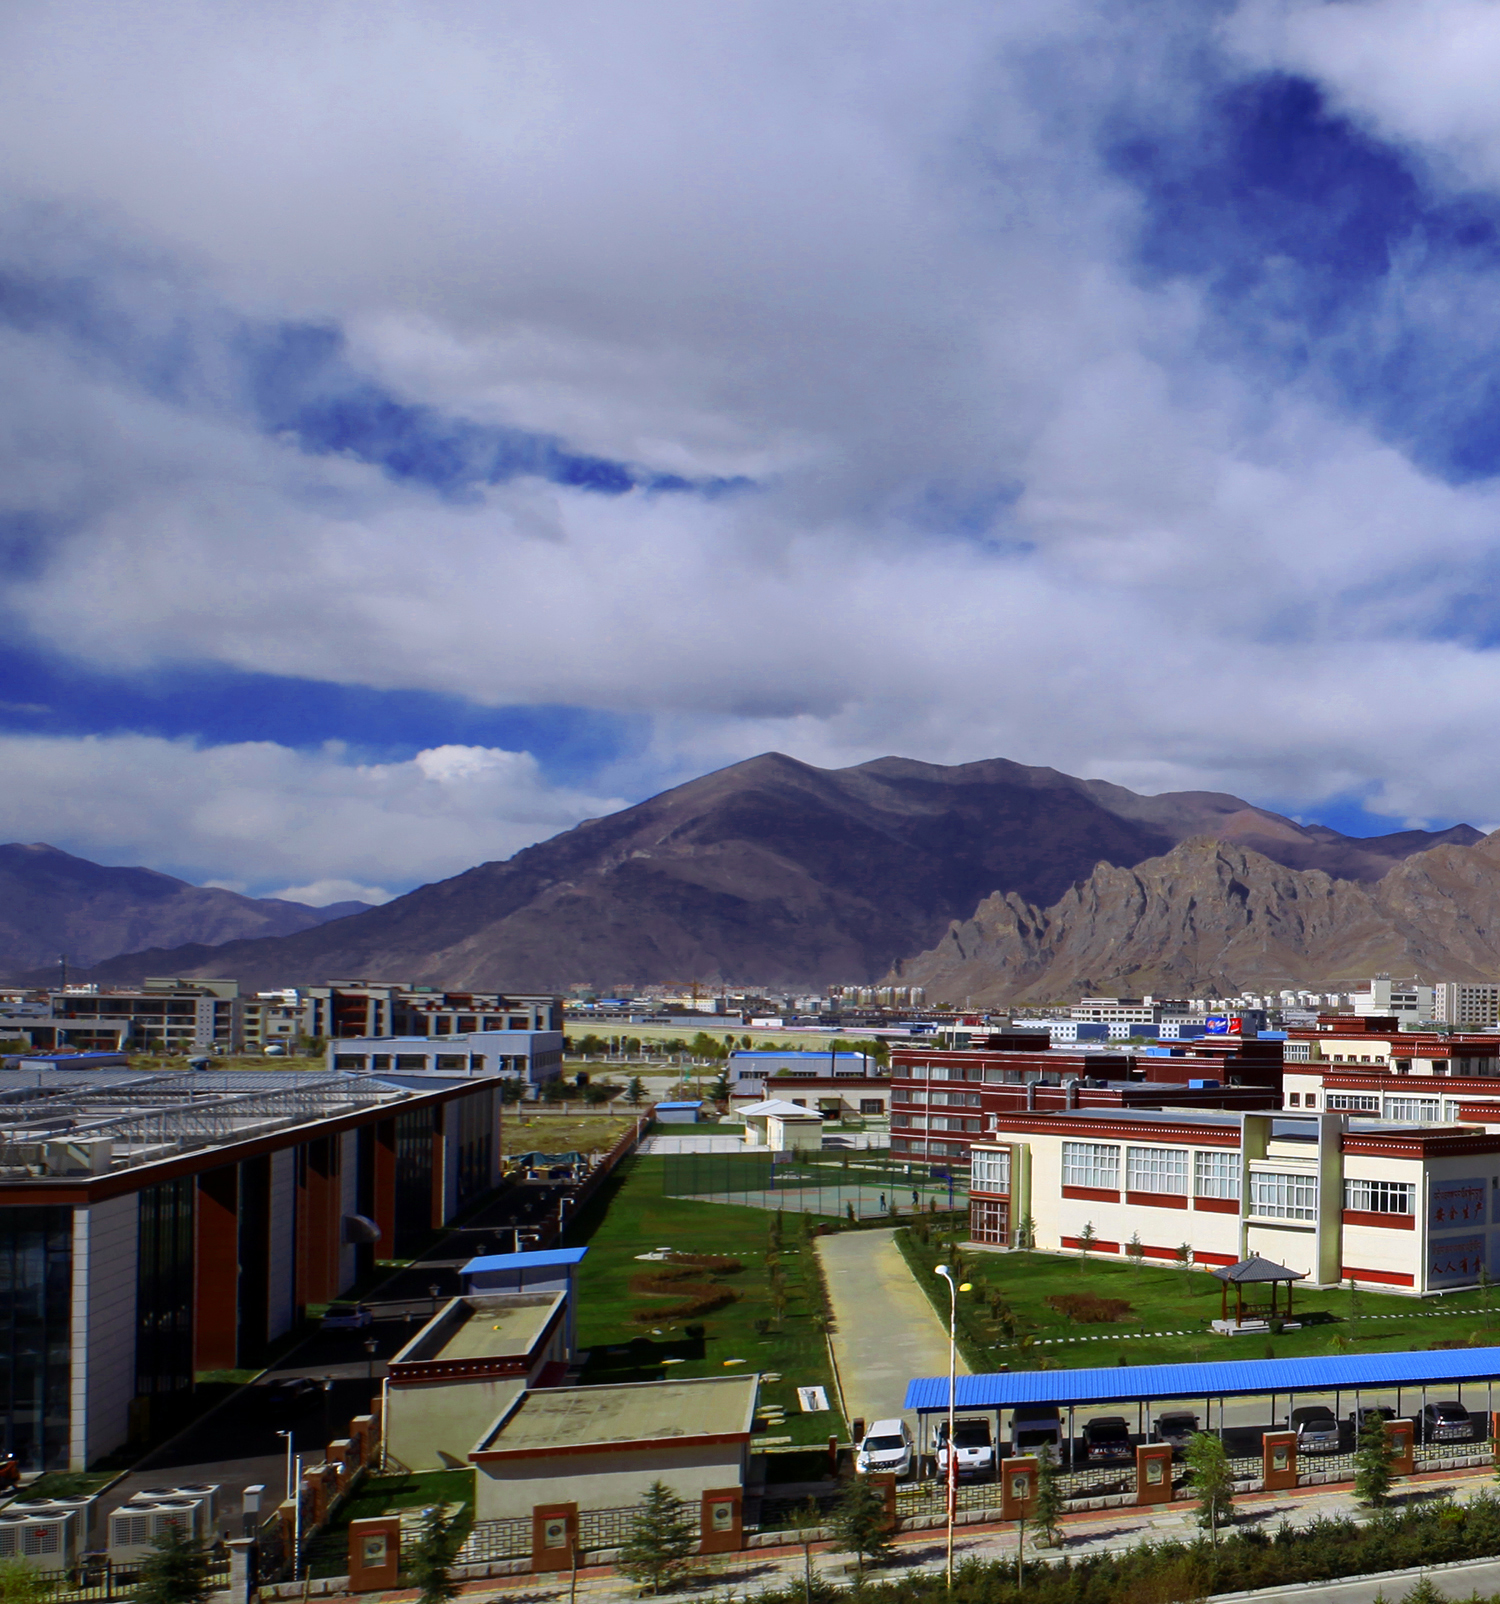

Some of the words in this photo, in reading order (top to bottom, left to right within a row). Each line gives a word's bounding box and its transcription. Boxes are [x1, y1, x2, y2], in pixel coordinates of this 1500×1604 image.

[1433, 1201, 1484, 1223] 安全生产
[1431, 1254, 1483, 1275] 人人有责
